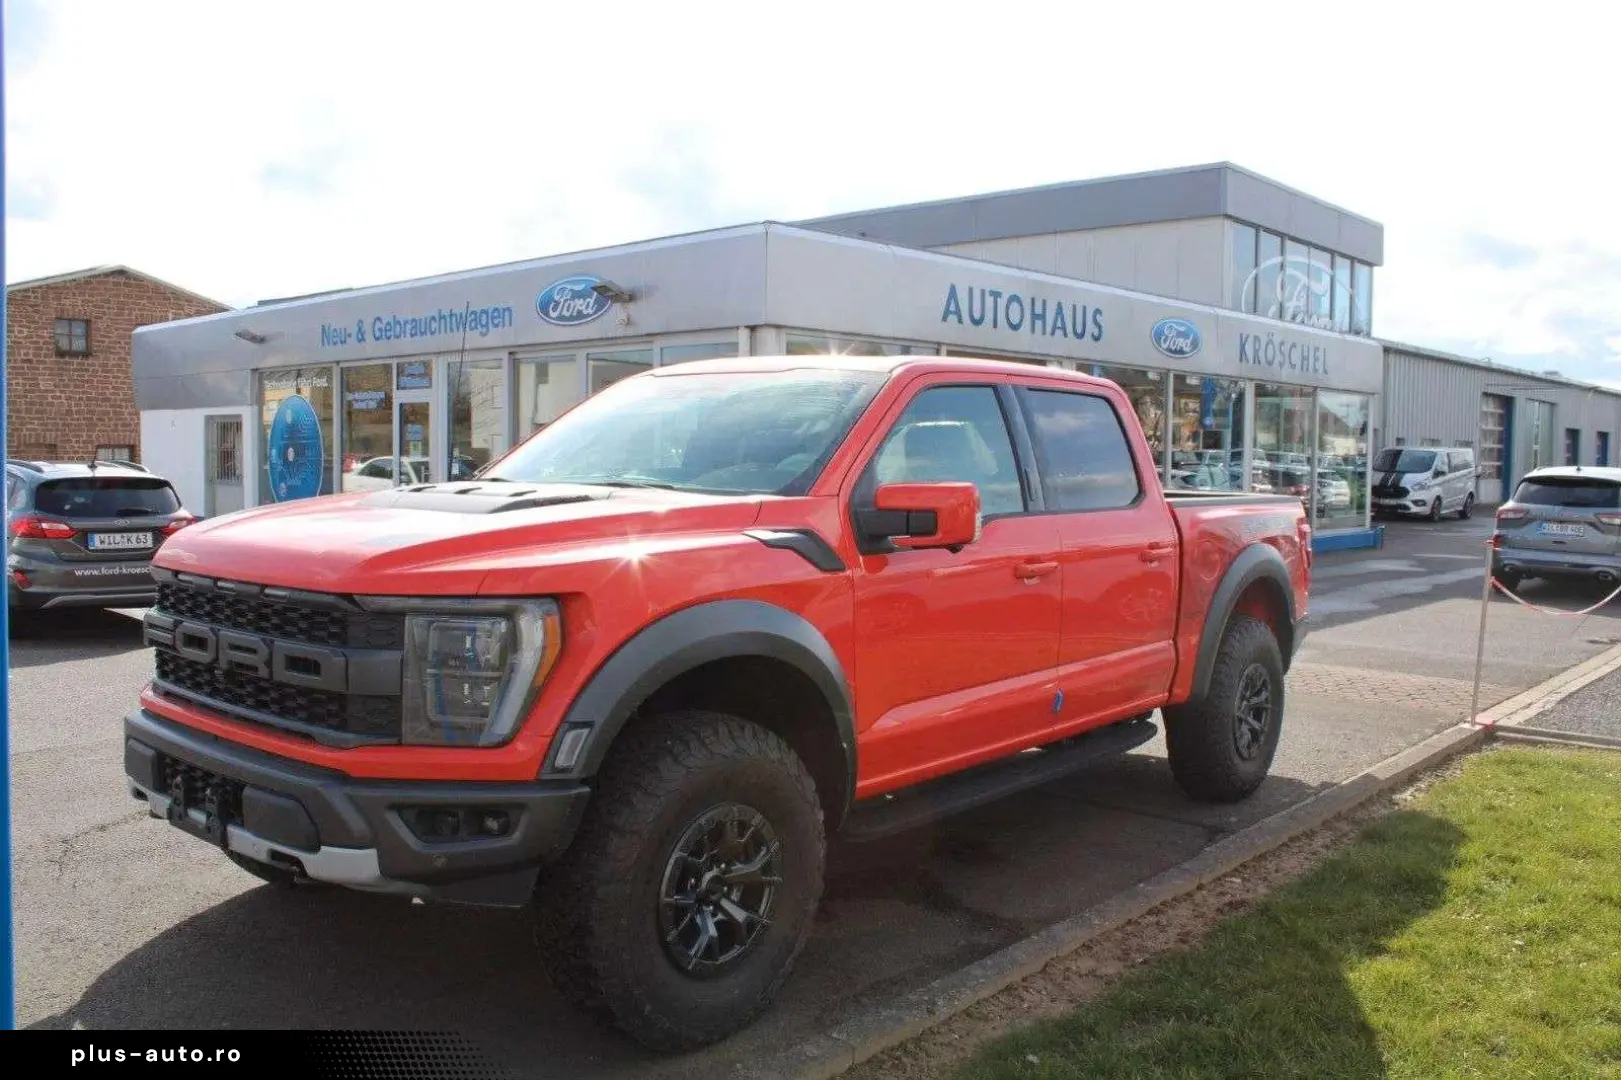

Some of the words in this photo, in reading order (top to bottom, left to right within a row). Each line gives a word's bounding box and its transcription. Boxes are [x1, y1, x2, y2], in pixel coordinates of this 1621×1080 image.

[549, 284, 598, 318] Ford
[941, 283, 1104, 342] AUTOHAUS
[320, 323, 352, 347] Neu-
[356, 319, 367, 343] &
[372, 304, 513, 341] Gebrauchtwagen
[1160, 322, 1195, 353] Ford
[1239, 331, 1330, 375] KRÖSCHEL
[98, 535, 121, 546] WIL
[143, 607, 348, 693] FORD
